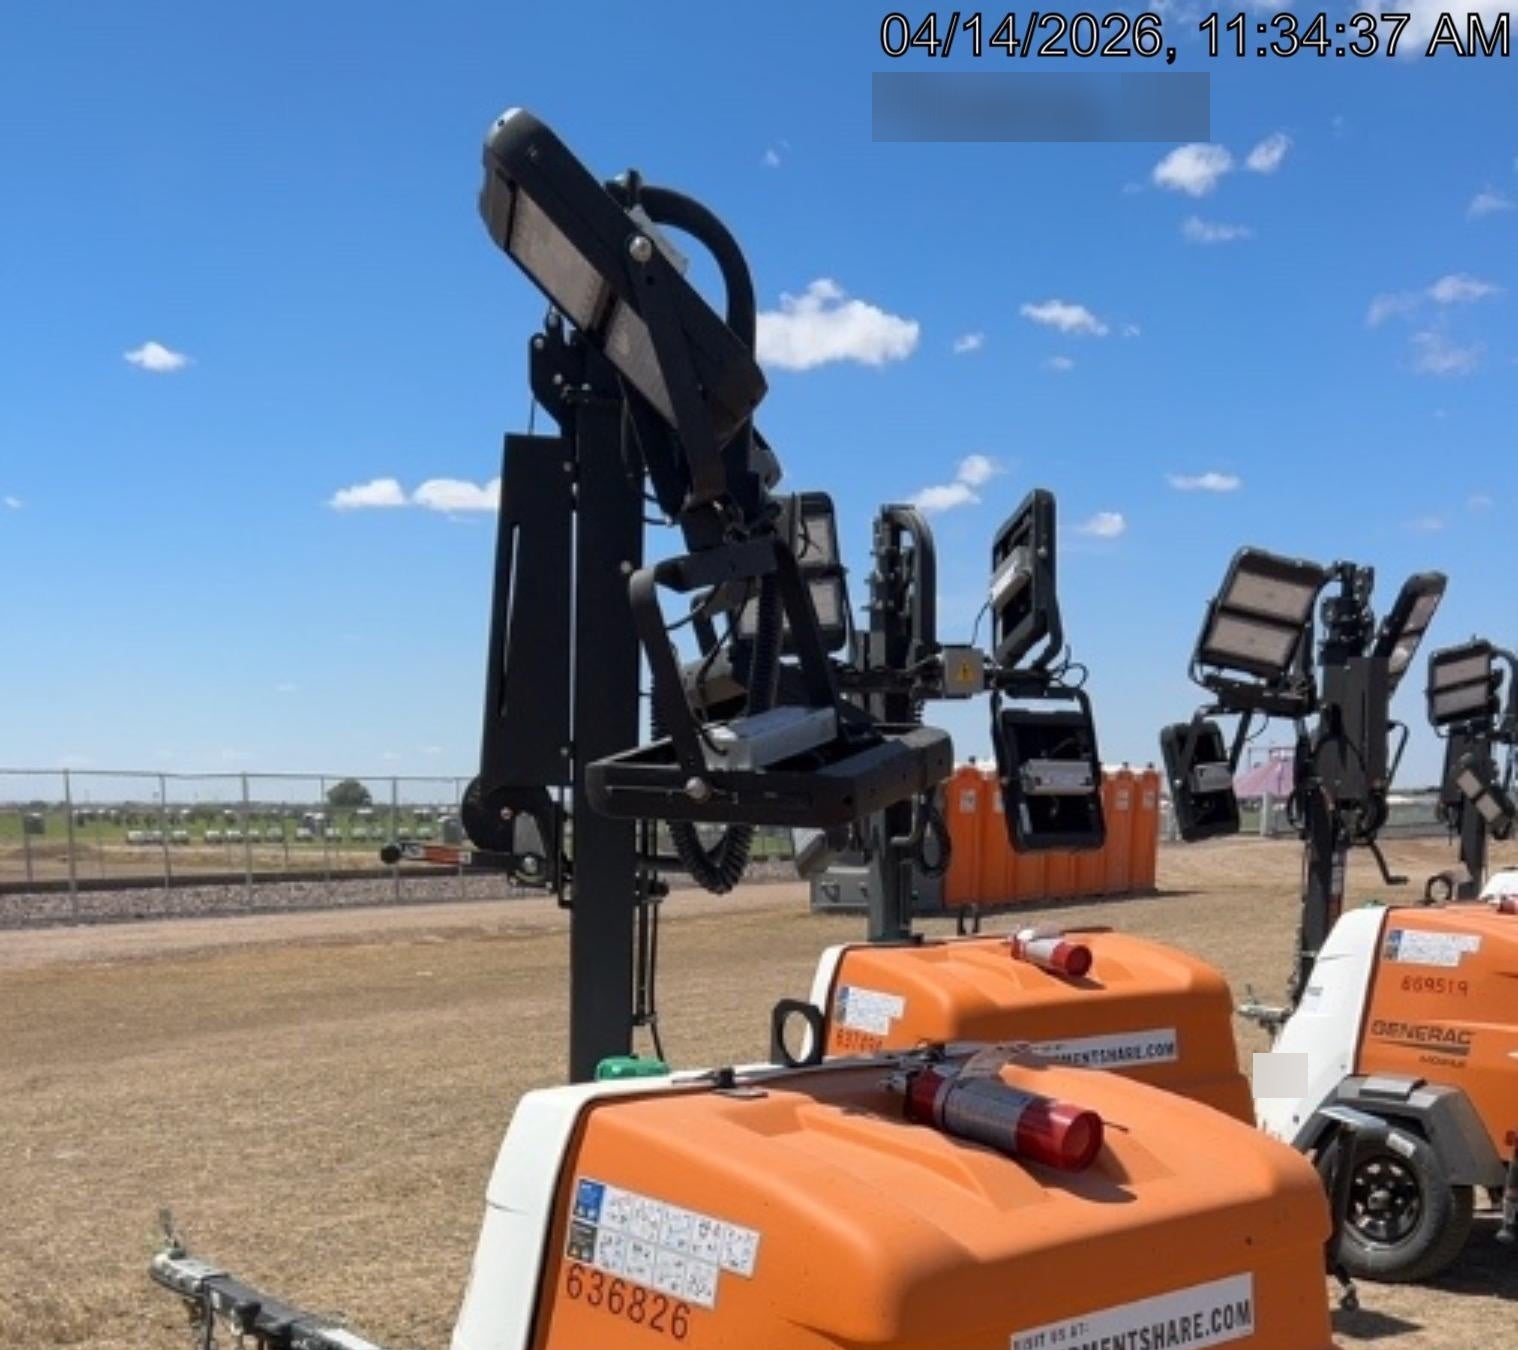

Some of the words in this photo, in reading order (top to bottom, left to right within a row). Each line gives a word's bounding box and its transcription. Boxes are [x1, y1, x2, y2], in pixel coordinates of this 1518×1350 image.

[1371, 1019, 1472, 1044] GENERAC
[566, 1263, 691, 1340] 636826
[1050, 1327, 1066, 1344] US
